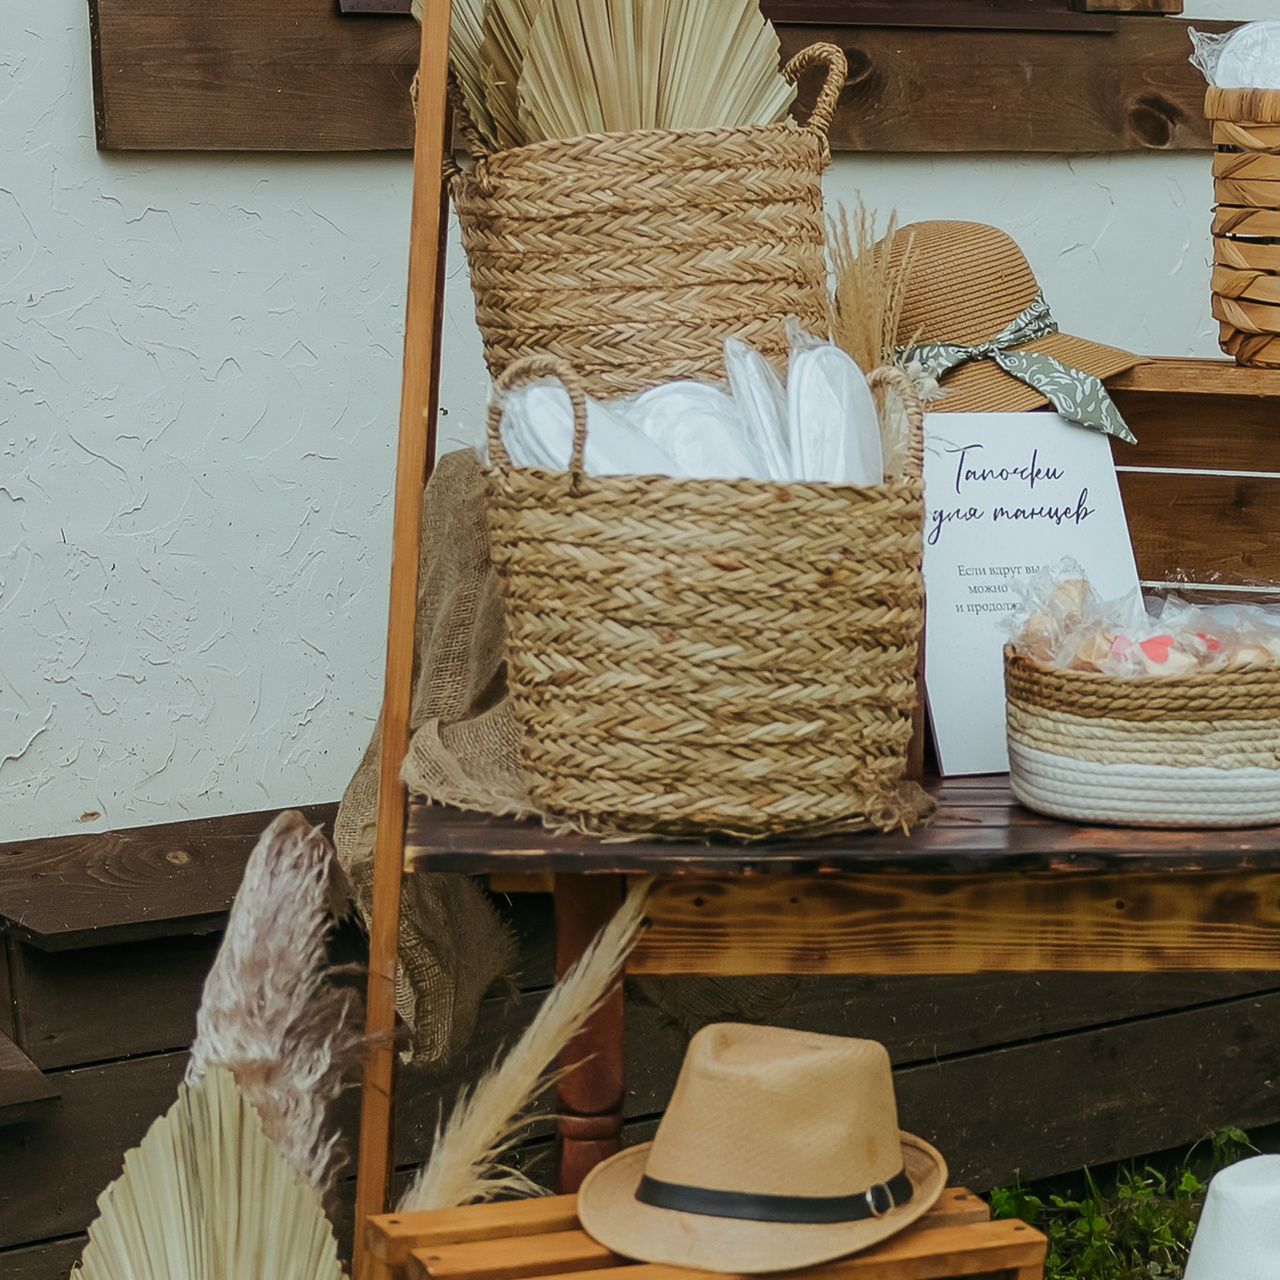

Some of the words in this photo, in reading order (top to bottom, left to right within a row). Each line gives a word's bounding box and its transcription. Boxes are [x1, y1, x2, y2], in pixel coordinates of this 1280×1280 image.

[944, 442, 1065, 495] Тапочки
[926, 505, 985, 546] для
[992, 486, 1096, 525] танцев
[957, 564, 987, 577] Если
[989, 565, 1022, 579] вдруг
[1024, 564, 1040, 575] вы
[967, 583, 1009, 595] можно
[955, 602, 964, 613] и
[966, 600, 1021, 616] продолж
